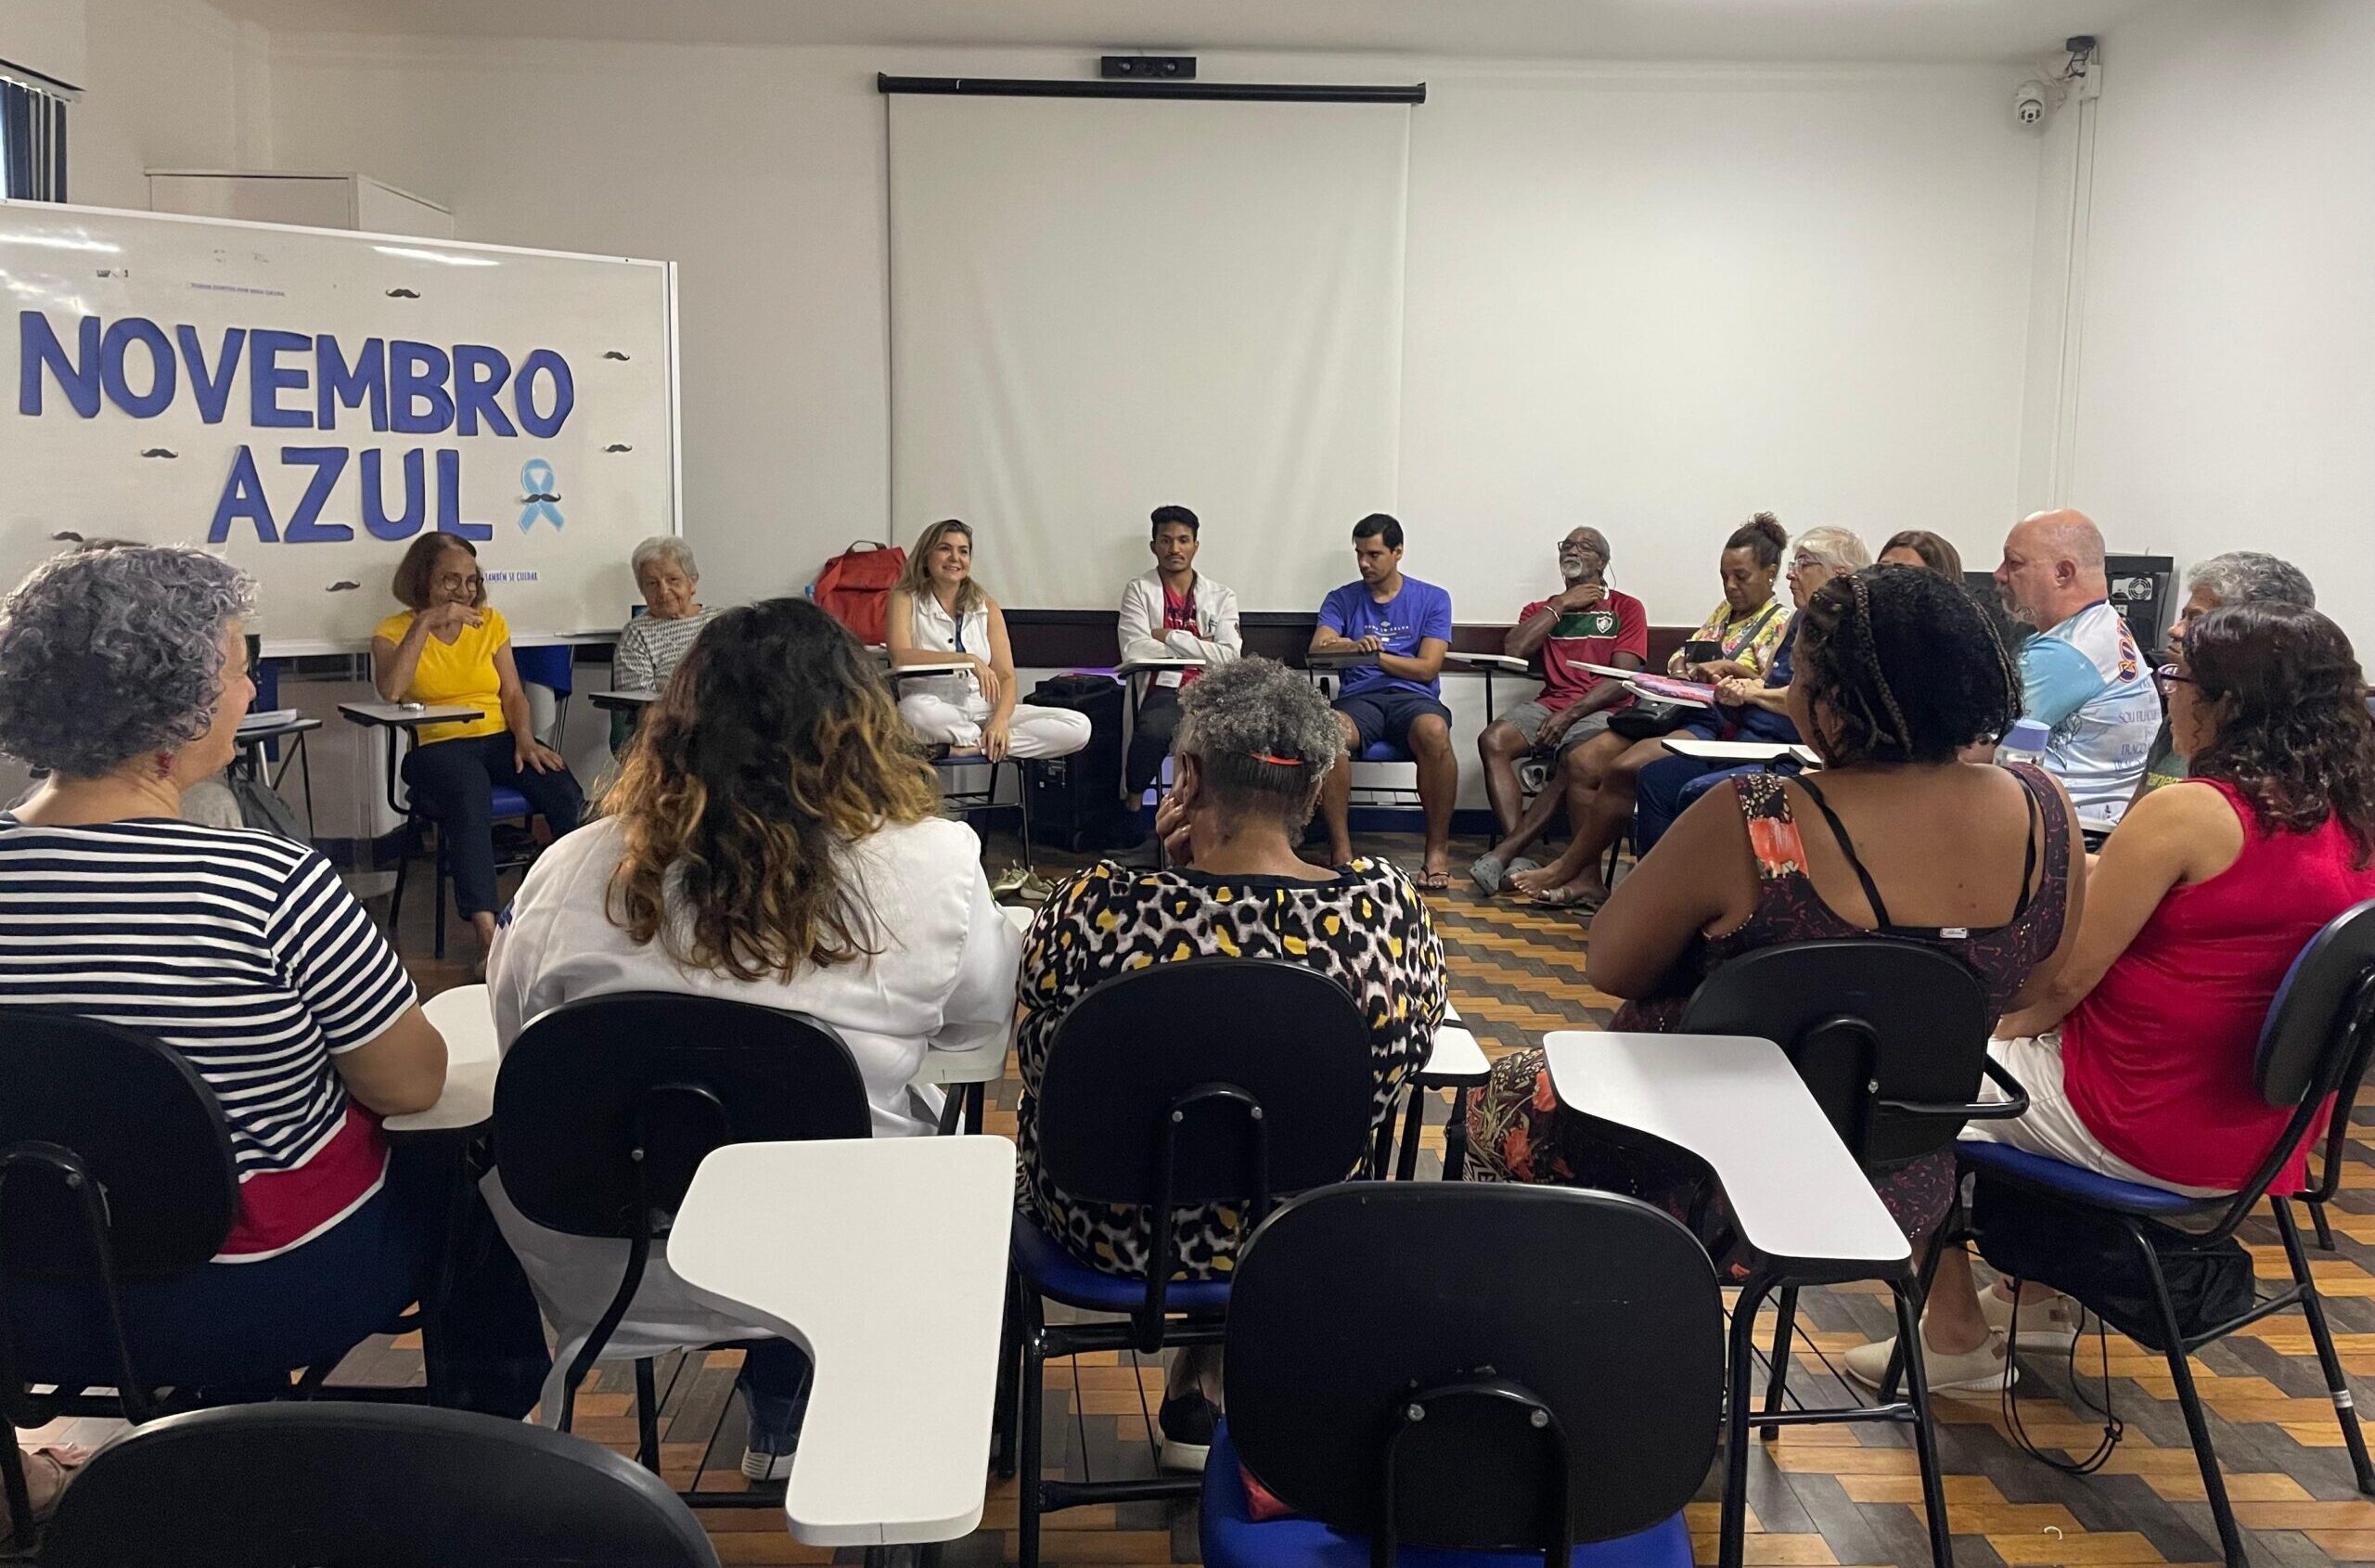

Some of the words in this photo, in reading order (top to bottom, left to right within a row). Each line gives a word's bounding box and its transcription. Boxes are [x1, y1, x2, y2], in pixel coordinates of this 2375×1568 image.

[19, 311, 574, 438] NOVEMBRO
[207, 445, 493, 544] AZUL
[516, 572, 538, 582] CUIDAR
